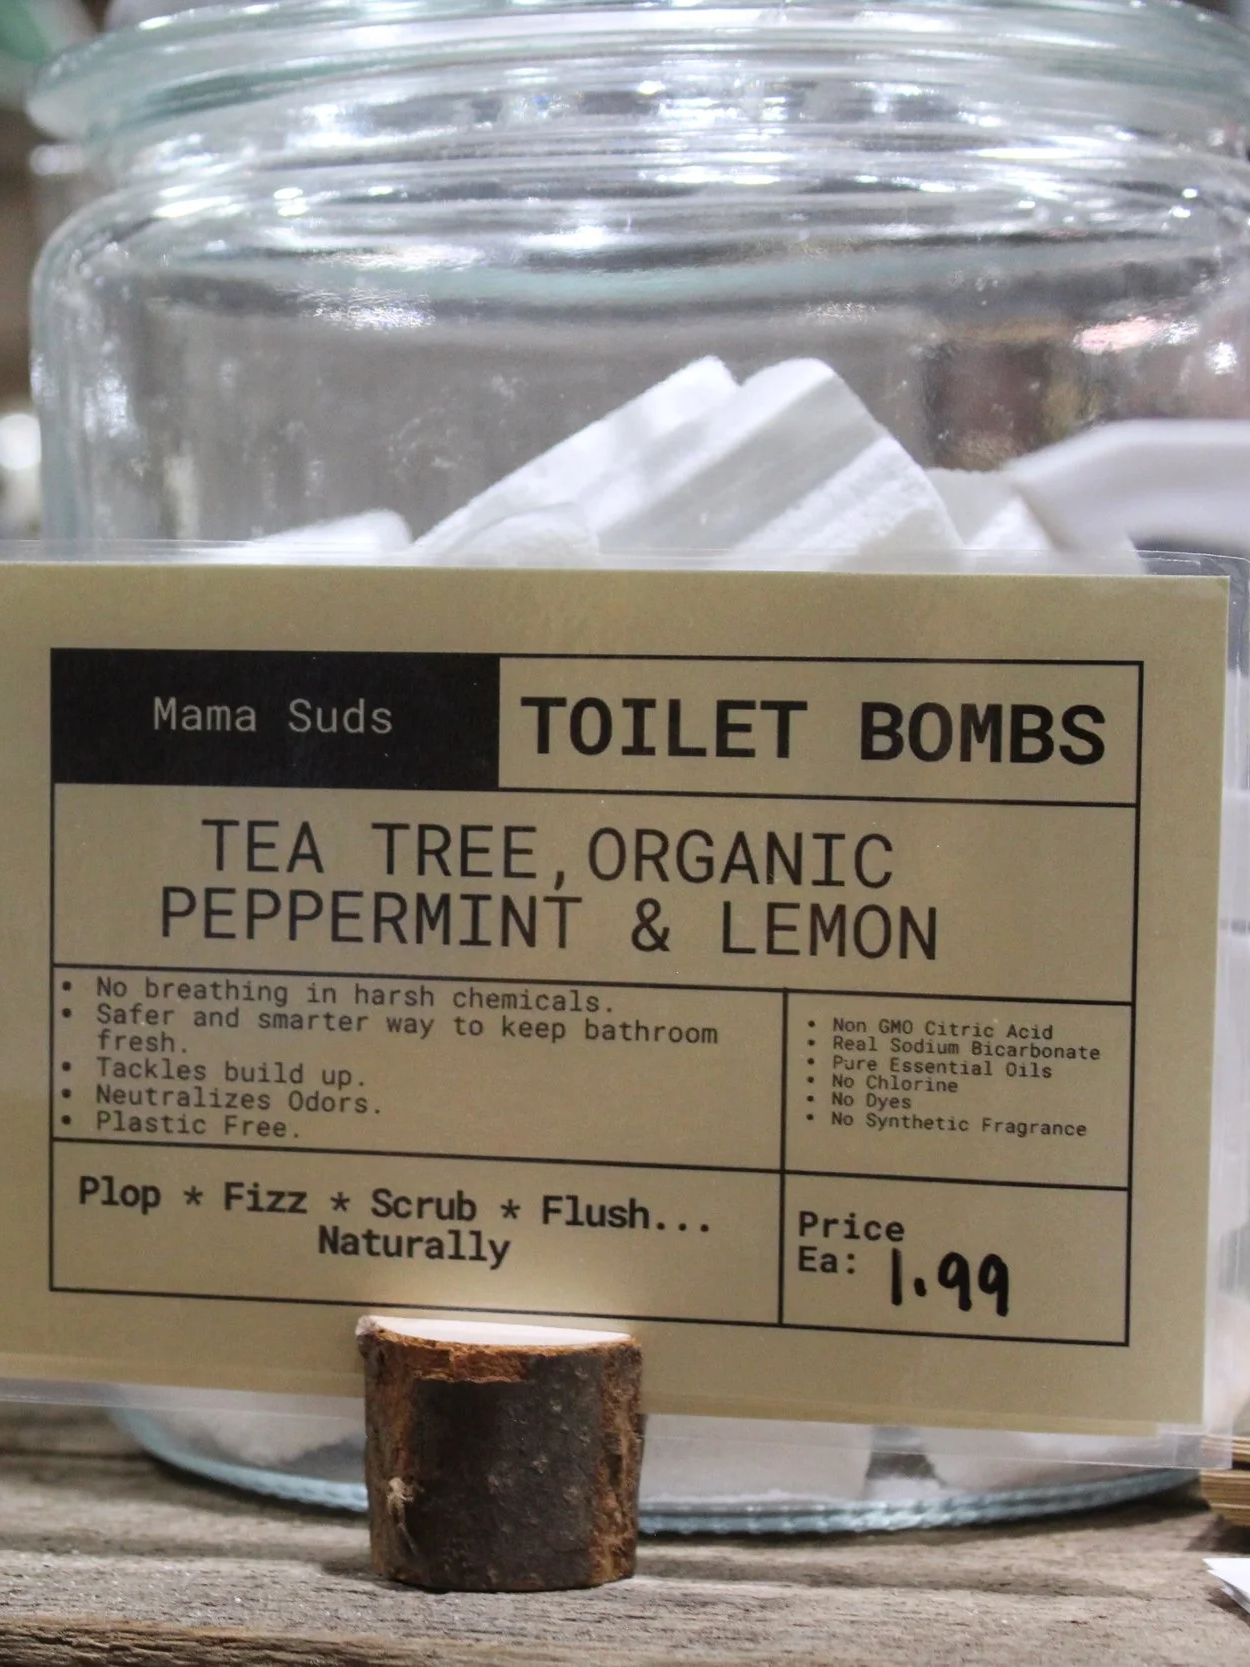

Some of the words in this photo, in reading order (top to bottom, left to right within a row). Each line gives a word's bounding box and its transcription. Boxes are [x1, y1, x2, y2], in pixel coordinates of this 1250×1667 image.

[155, 697, 255, 731] Mama
[289, 698, 392, 733] Suds
[521, 697, 807, 758] TOILET
[858, 698, 1108, 768] BOMBS
[202, 819, 324, 873] TEA
[163, 884, 582, 948] PEPPERMINT
[632, 898, 670, 952] &
[723, 901, 936, 960] LEMON
[97, 976, 127, 997] No
[146, 975, 291, 1006] breathing
[308, 983, 336, 1003] in
[356, 983, 433, 1006] harsh
[453, 985, 615, 1012] chemicals.
[98, 1003, 174, 1025] Safer
[194, 1007, 239, 1027] and
[259, 1012, 368, 1031] smarter
[387, 1018, 433, 1039] way
[454, 1017, 483, 1036] to
[502, 1015, 566, 1043] keep
[585, 1018, 717, 1043] bathroom
[833, 1018, 866, 1032] Non
[879, 1019, 912, 1034] GMO
[925, 1021, 994, 1038] Citric
[1006, 1024, 1052, 1040] Acid
[98, 1028, 186, 1053] fresh.
[834, 1036, 877, 1051] Real
[891, 1038, 959, 1054] Sodium
[972, 1041, 1100, 1060] Bicarbonate
[97, 1057, 206, 1080] Tackles
[225, 1061, 302, 1084] build
[322, 1070, 363, 1090] up.
[833, 1055, 877, 1071] Pure
[890, 1057, 992, 1076] Essential
[1006, 1062, 1052, 1078] Oils
[833, 1074, 854, 1088] No
[866, 1072, 958, 1093] Chlorine
[97, 1084, 270, 1112] Neutralizes
[289, 1088, 380, 1114] Odors.
[832, 1092, 854, 1106] No
[867, 1093, 910, 1111] Dyes
[97, 1110, 205, 1134] Plastic
[225, 1115, 298, 1138] Free.
[832, 1112, 853, 1125] No
[867, 1113, 968, 1131] Synthetic
[982, 1118, 1086, 1138] Fragrance
[80, 1176, 161, 1215] Plop
[225, 1182, 307, 1214] Fizz
[372, 1188, 476, 1221] Scrub
[543, 1195, 709, 1232] Flush...
[799, 1211, 904, 1242] Price
[319, 1225, 510, 1269] Naturally
[799, 1246, 854, 1274] Ea:
[891, 1248, 1009, 1317] 1.99
